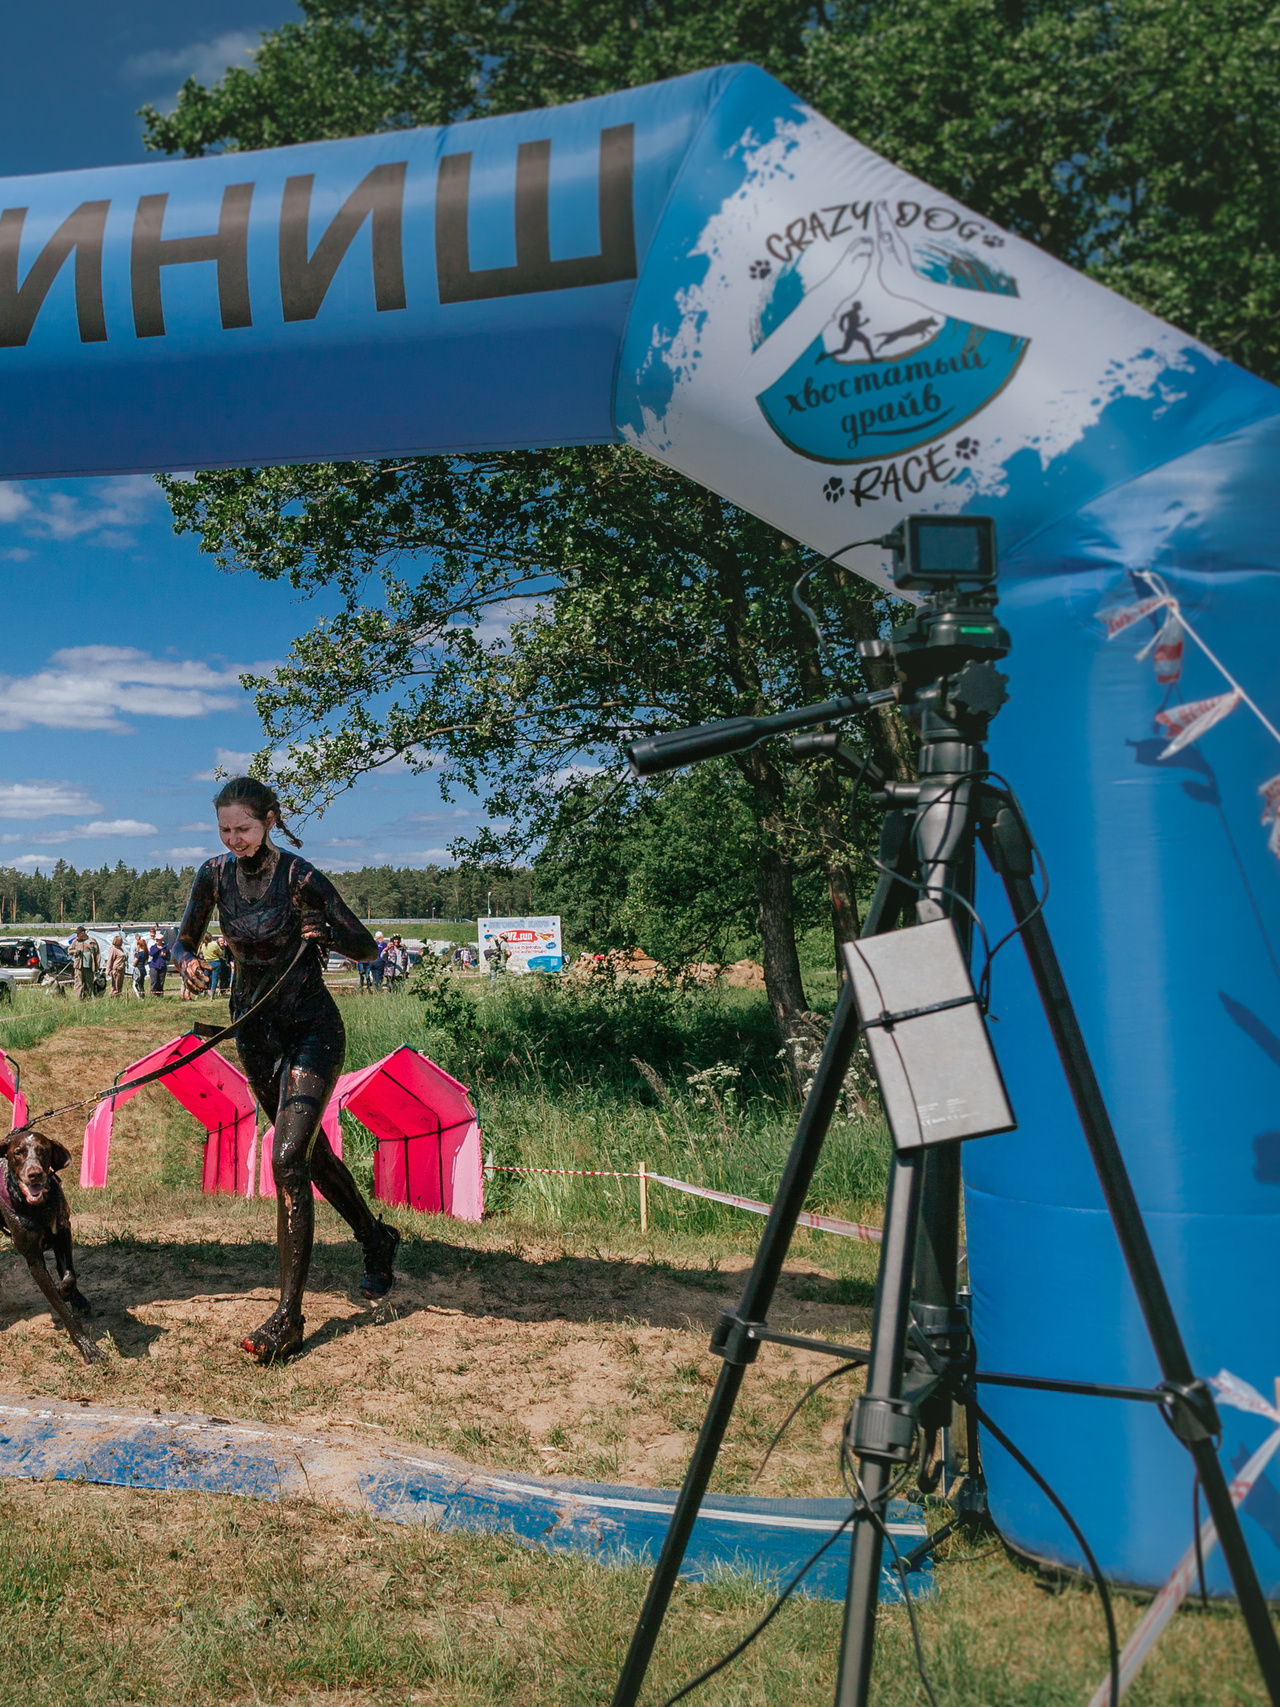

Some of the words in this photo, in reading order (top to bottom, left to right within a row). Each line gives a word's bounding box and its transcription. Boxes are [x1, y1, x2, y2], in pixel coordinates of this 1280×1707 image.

[765, 200, 874, 263] CRAZY
[896, 200, 986, 243] DOG
[783, 349, 993, 416] хвостатый
[841, 383, 944, 450] драйв
[849, 443, 957, 507] RACE
